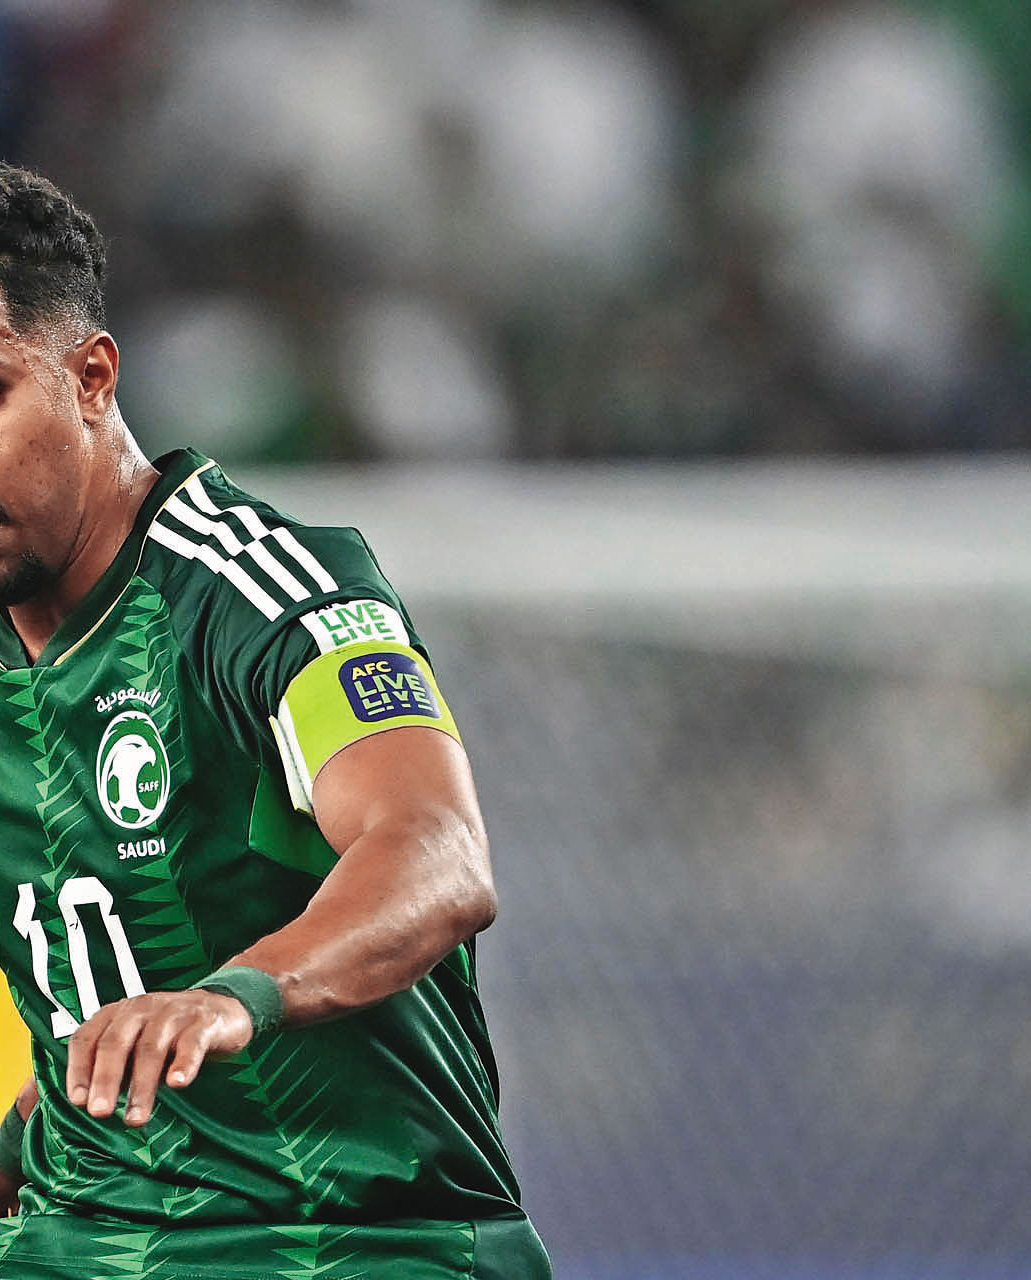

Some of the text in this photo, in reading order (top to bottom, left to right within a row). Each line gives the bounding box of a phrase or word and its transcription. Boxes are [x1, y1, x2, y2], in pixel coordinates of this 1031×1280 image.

[318, 602, 385, 632] LIVE
[331, 622, 397, 646] LIVE
[352, 661, 392, 680] AFC
[354, 672, 427, 699] LIVE
[94, 687, 162, 713] السعودية
[362, 690, 434, 716] LIVE
[137, 780, 159, 793] SAFF
[117, 837, 167, 860] SAUDI
[12, 876, 147, 1039] 10
